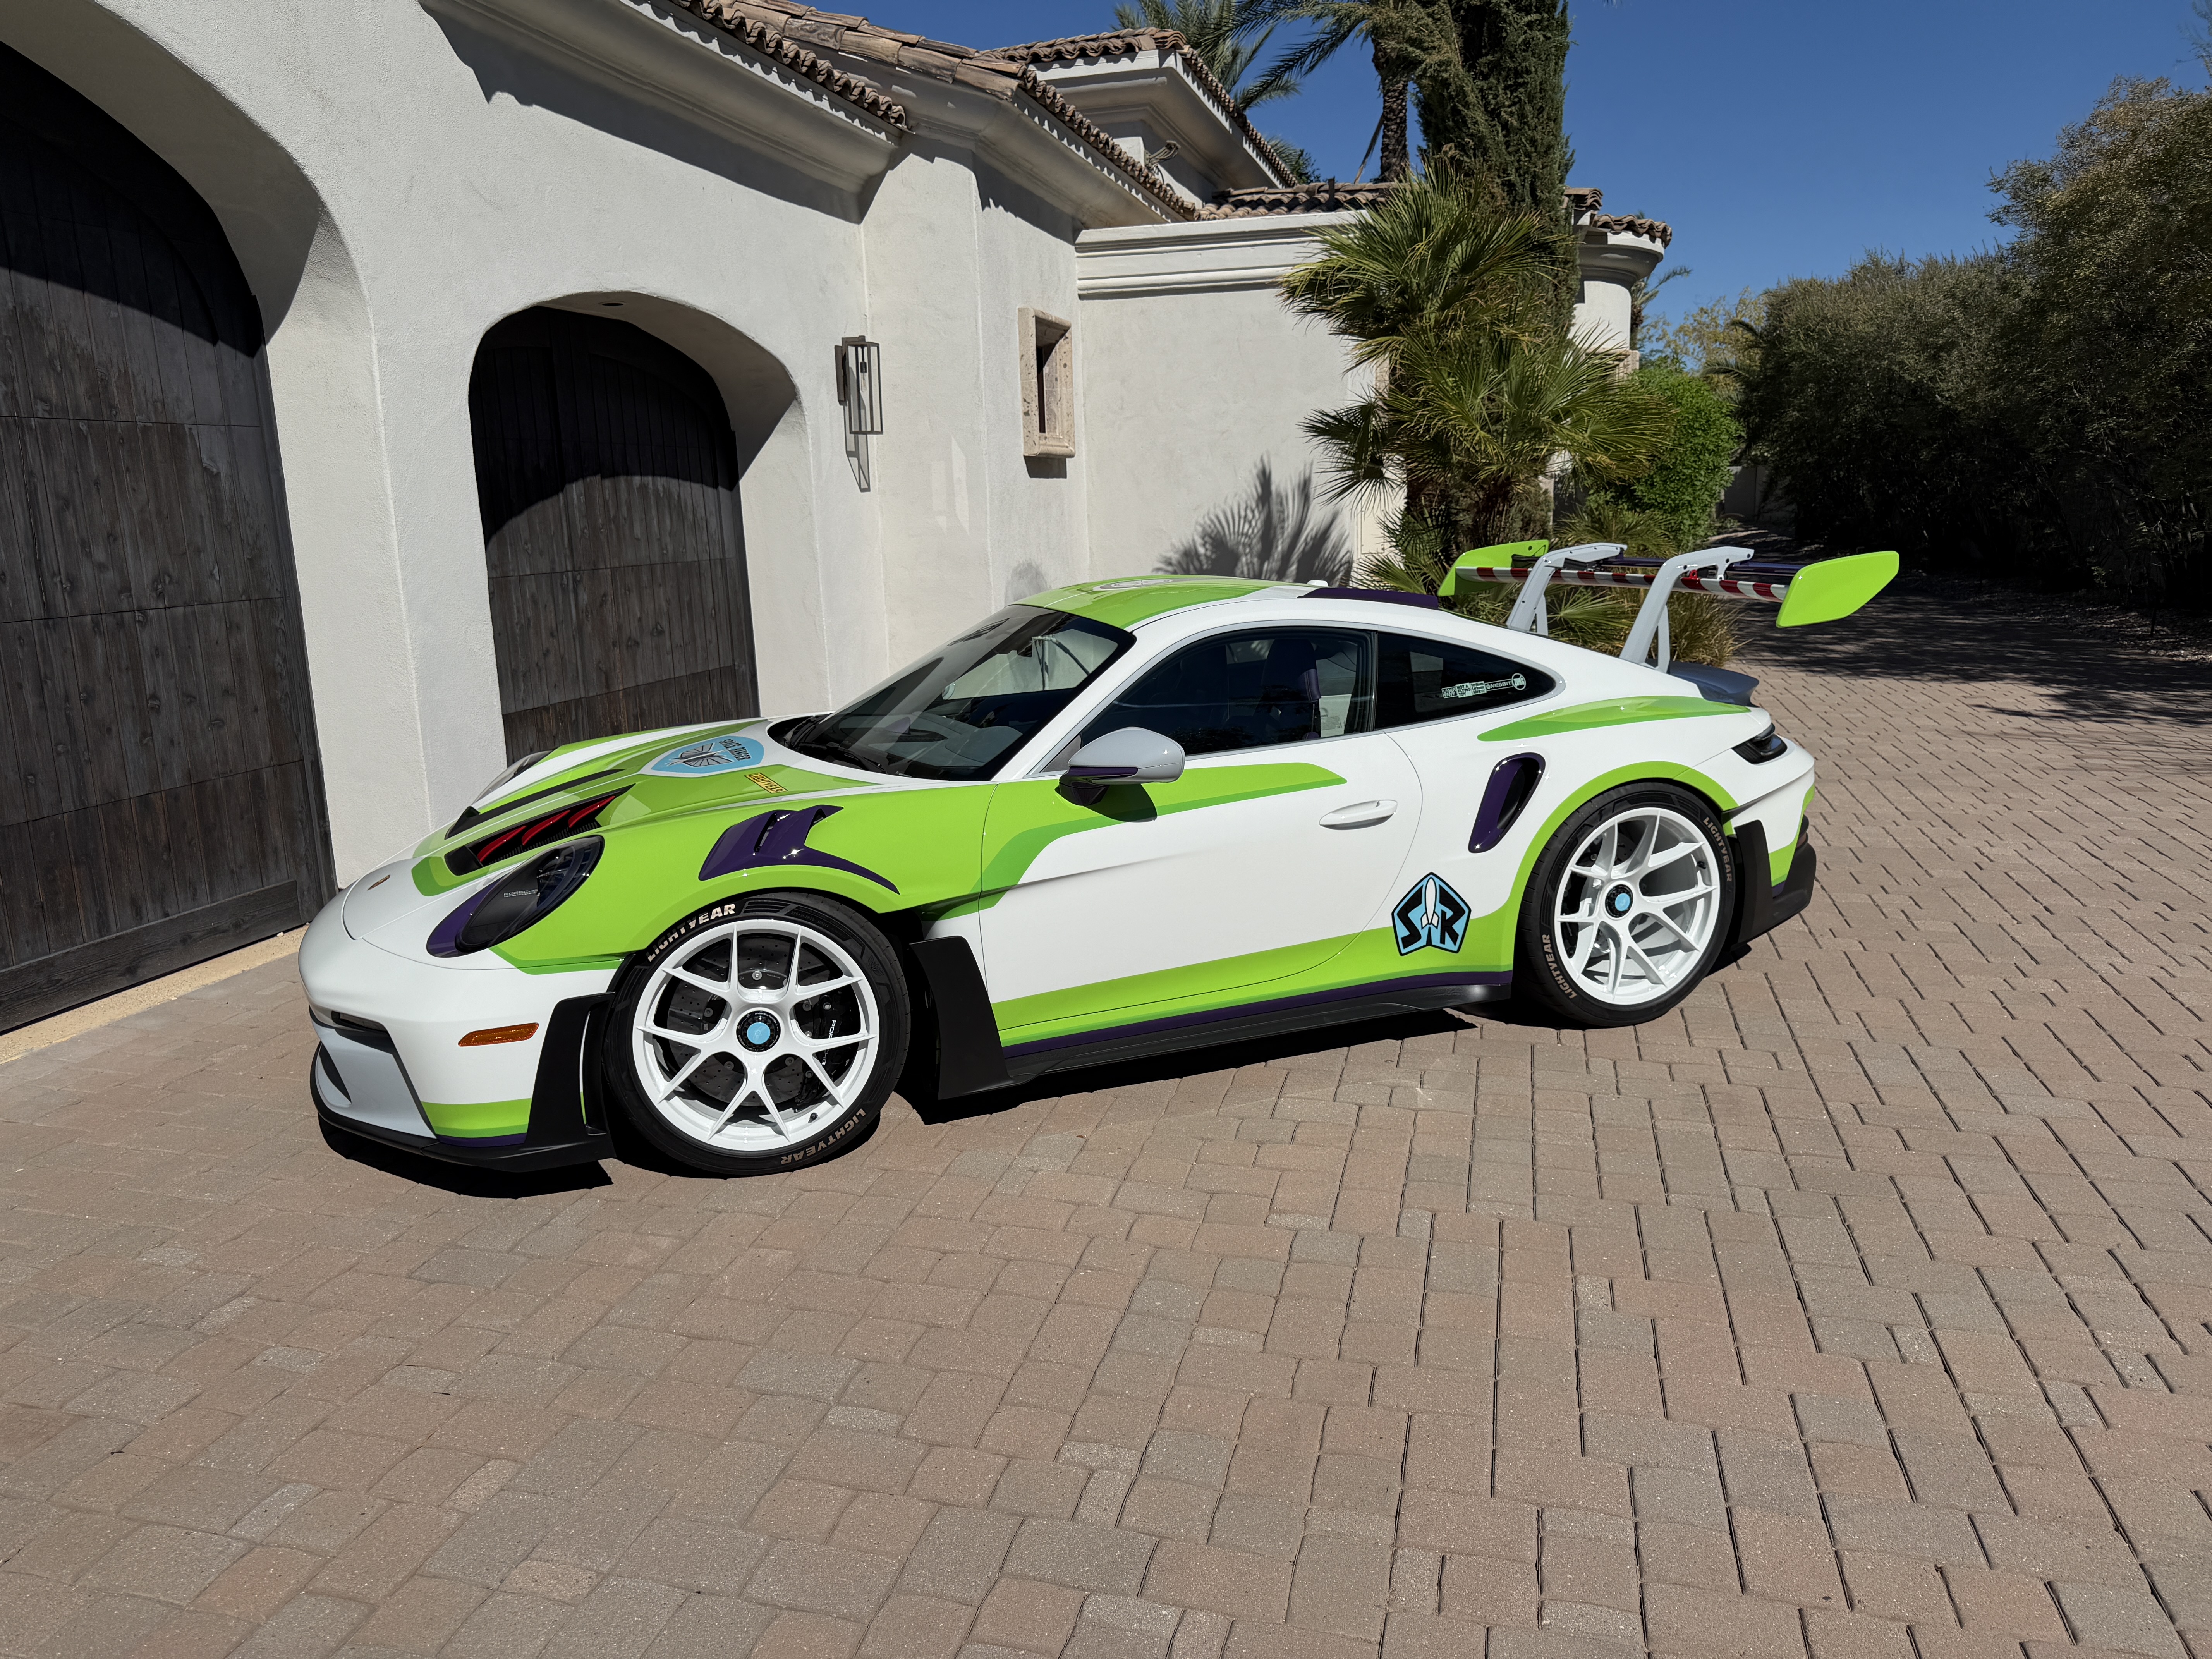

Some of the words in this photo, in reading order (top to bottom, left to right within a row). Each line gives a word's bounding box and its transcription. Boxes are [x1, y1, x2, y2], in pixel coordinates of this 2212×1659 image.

[748, 774, 784, 793] LIGHTYEAR
[1703, 816, 1733, 882] LIGHTYEAR
[645, 903, 736, 962] LIGHTYEAR
[1542, 934, 1578, 1000] LIGHTYEAR
[781, 1109, 866, 1166] LIGHTYEAR
